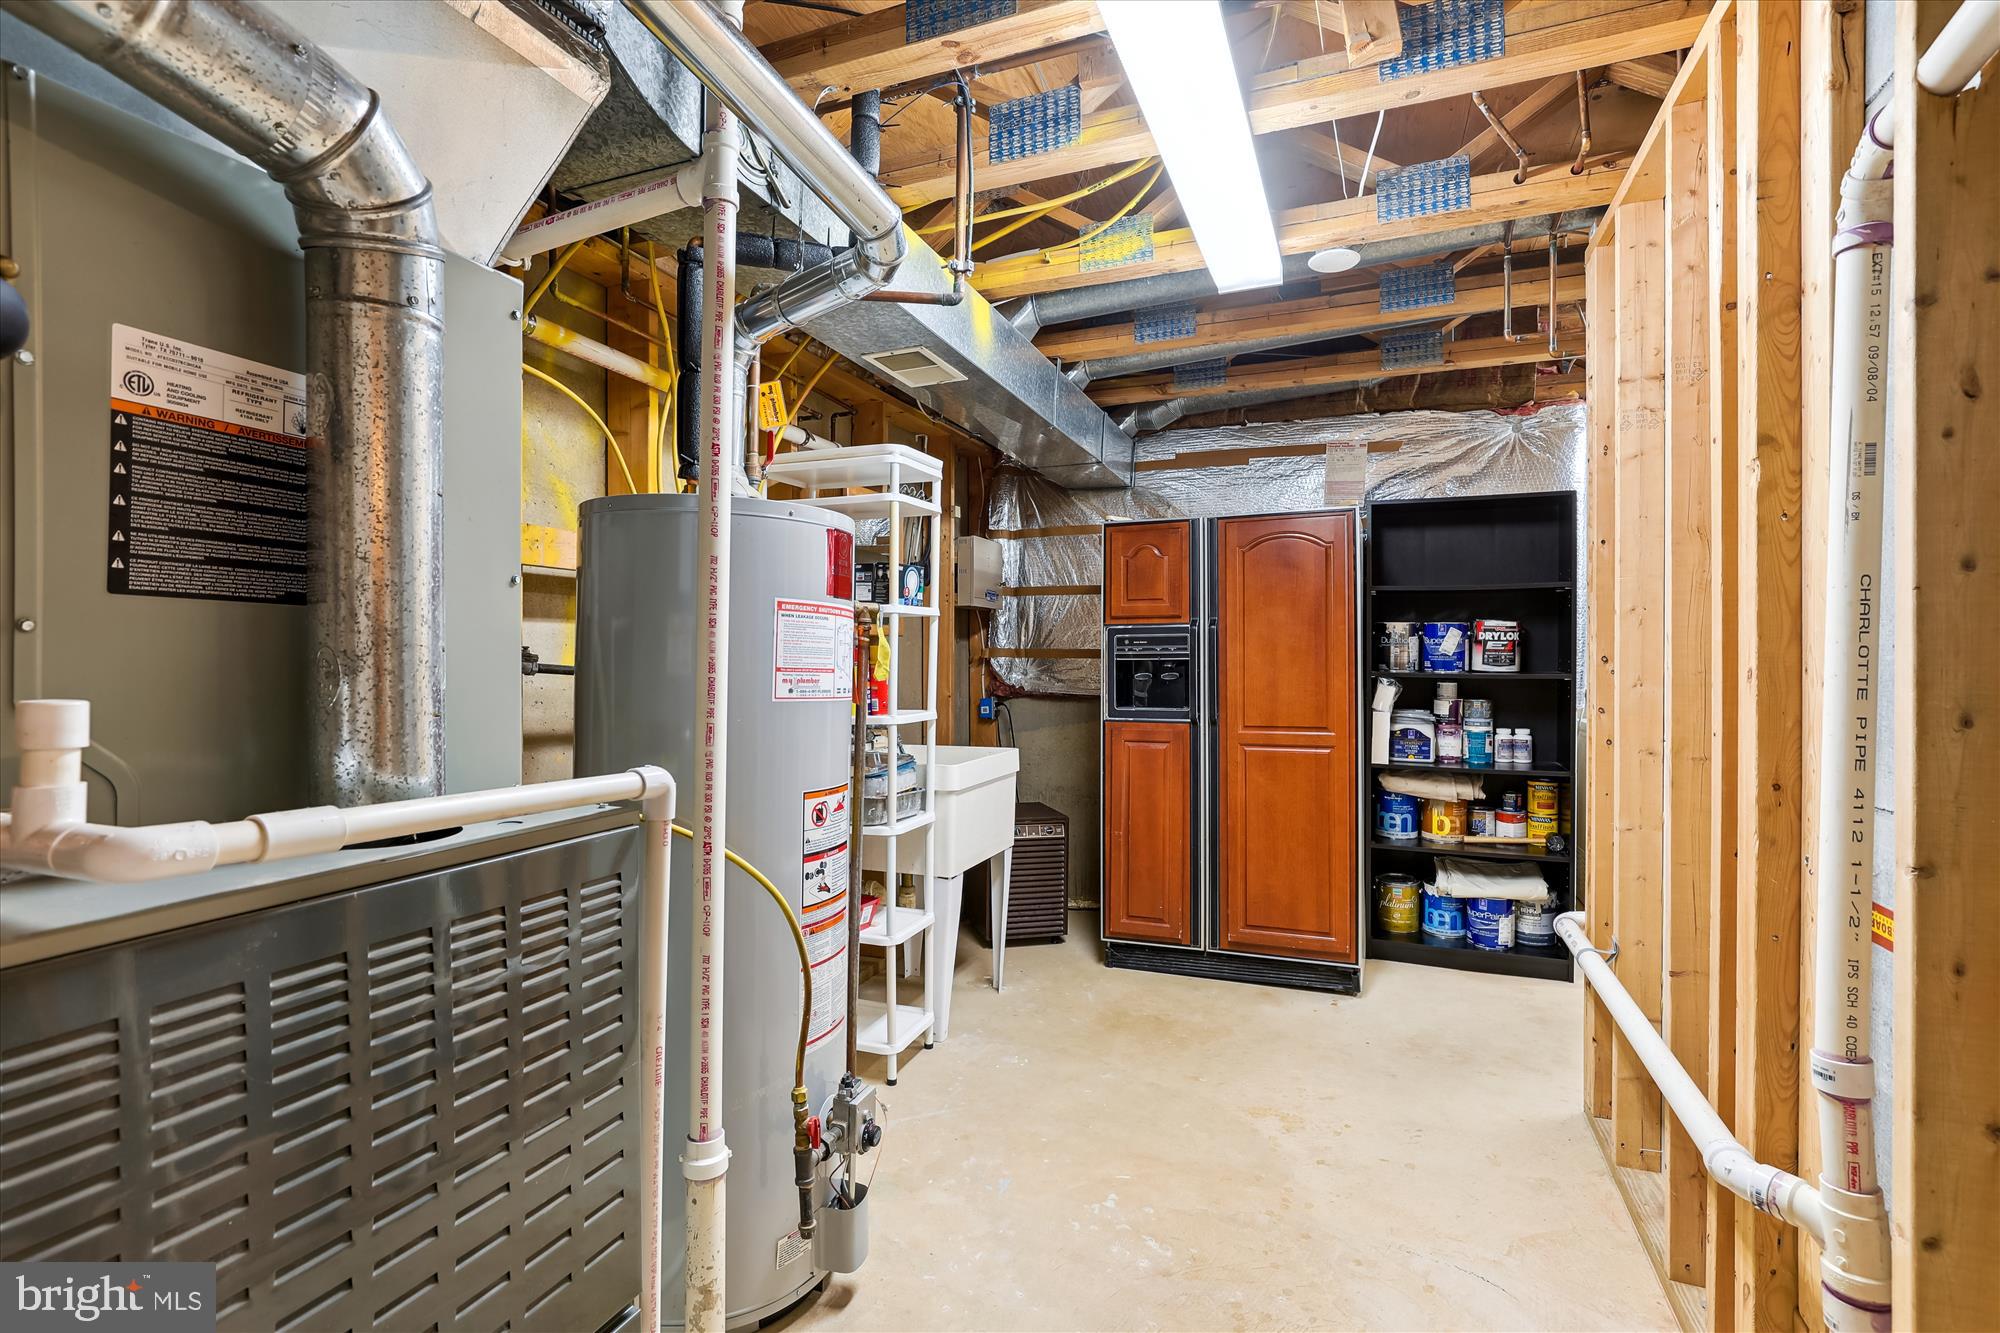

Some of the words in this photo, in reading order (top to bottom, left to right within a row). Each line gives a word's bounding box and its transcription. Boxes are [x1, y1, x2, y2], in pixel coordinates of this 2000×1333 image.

[716, 281, 724, 308] CHARLOTTE
[715, 311, 723, 322] PIPE
[1866, 346, 1880, 402] 09/08/04
[167, 381, 191, 391] HEATING
[167, 393, 200, 404] EQUIPMENT
[180, 390, 206, 400] COOLING
[232, 389, 276, 403] REFRIGERANT
[235, 408, 272, 419] REFRIGERANT
[157, 409, 215, 428] WARNING
[238, 426, 305, 448] AVERTISSEM
[711, 442, 720, 457] ASTM
[782, 604, 817, 612] EMERGENCY
[708, 617, 717, 629] SCH
[1479, 632, 1519, 640] DRYLOK
[1857, 574, 1871, 701] CHARLOTTE
[707, 677, 716, 705] CHARLOTTE
[706, 707, 714, 719] PIPE
[1855, 717, 1867, 772] PIPE
[705, 759, 713, 769] PVC
[704, 793, 712, 803] 330
[704, 805, 712, 814] PSI
[1852, 788, 1865, 843] 4112
[703, 841, 712, 856] ASTM
[702, 905, 711, 937] CP-110P
[1425, 899, 1461, 931] ben
[1847, 959, 1859, 980] IPS
[702, 984, 710, 995] PVC
[1847, 987, 1858, 1008] SCH
[700, 1017, 709, 1029] SCH
[1846, 1015, 1858, 1029] 40
[700, 1076, 709, 1105] CHARLOTTE
[699, 1107, 708, 1120] PIPE
